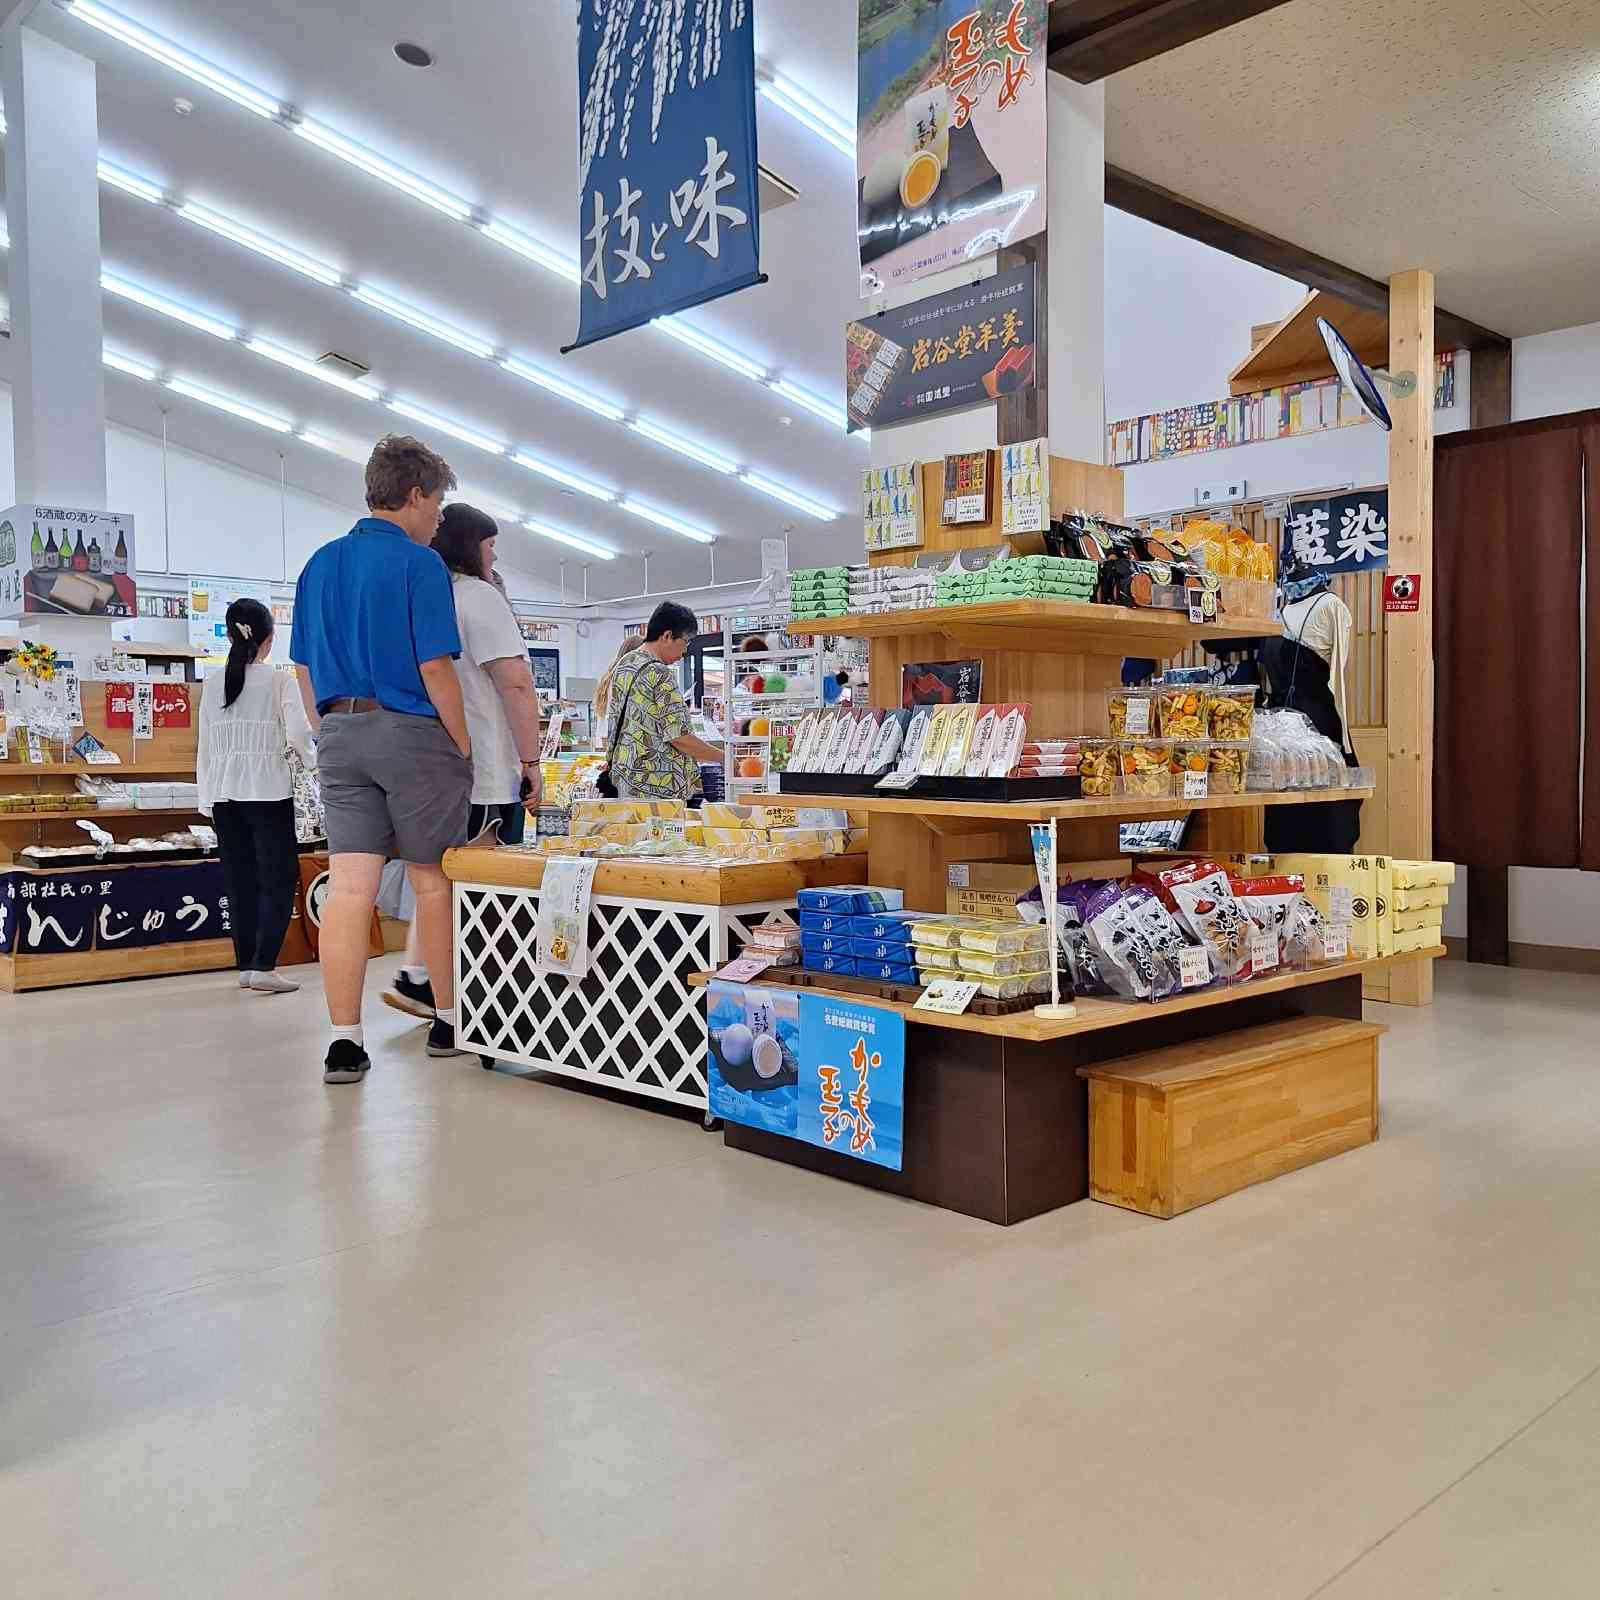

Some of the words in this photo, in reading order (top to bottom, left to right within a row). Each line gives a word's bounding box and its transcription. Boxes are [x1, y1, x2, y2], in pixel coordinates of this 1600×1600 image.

[1287, 503, 1388, 566] 藍染
[111, 697, 187, 713] 酒まじゅう
